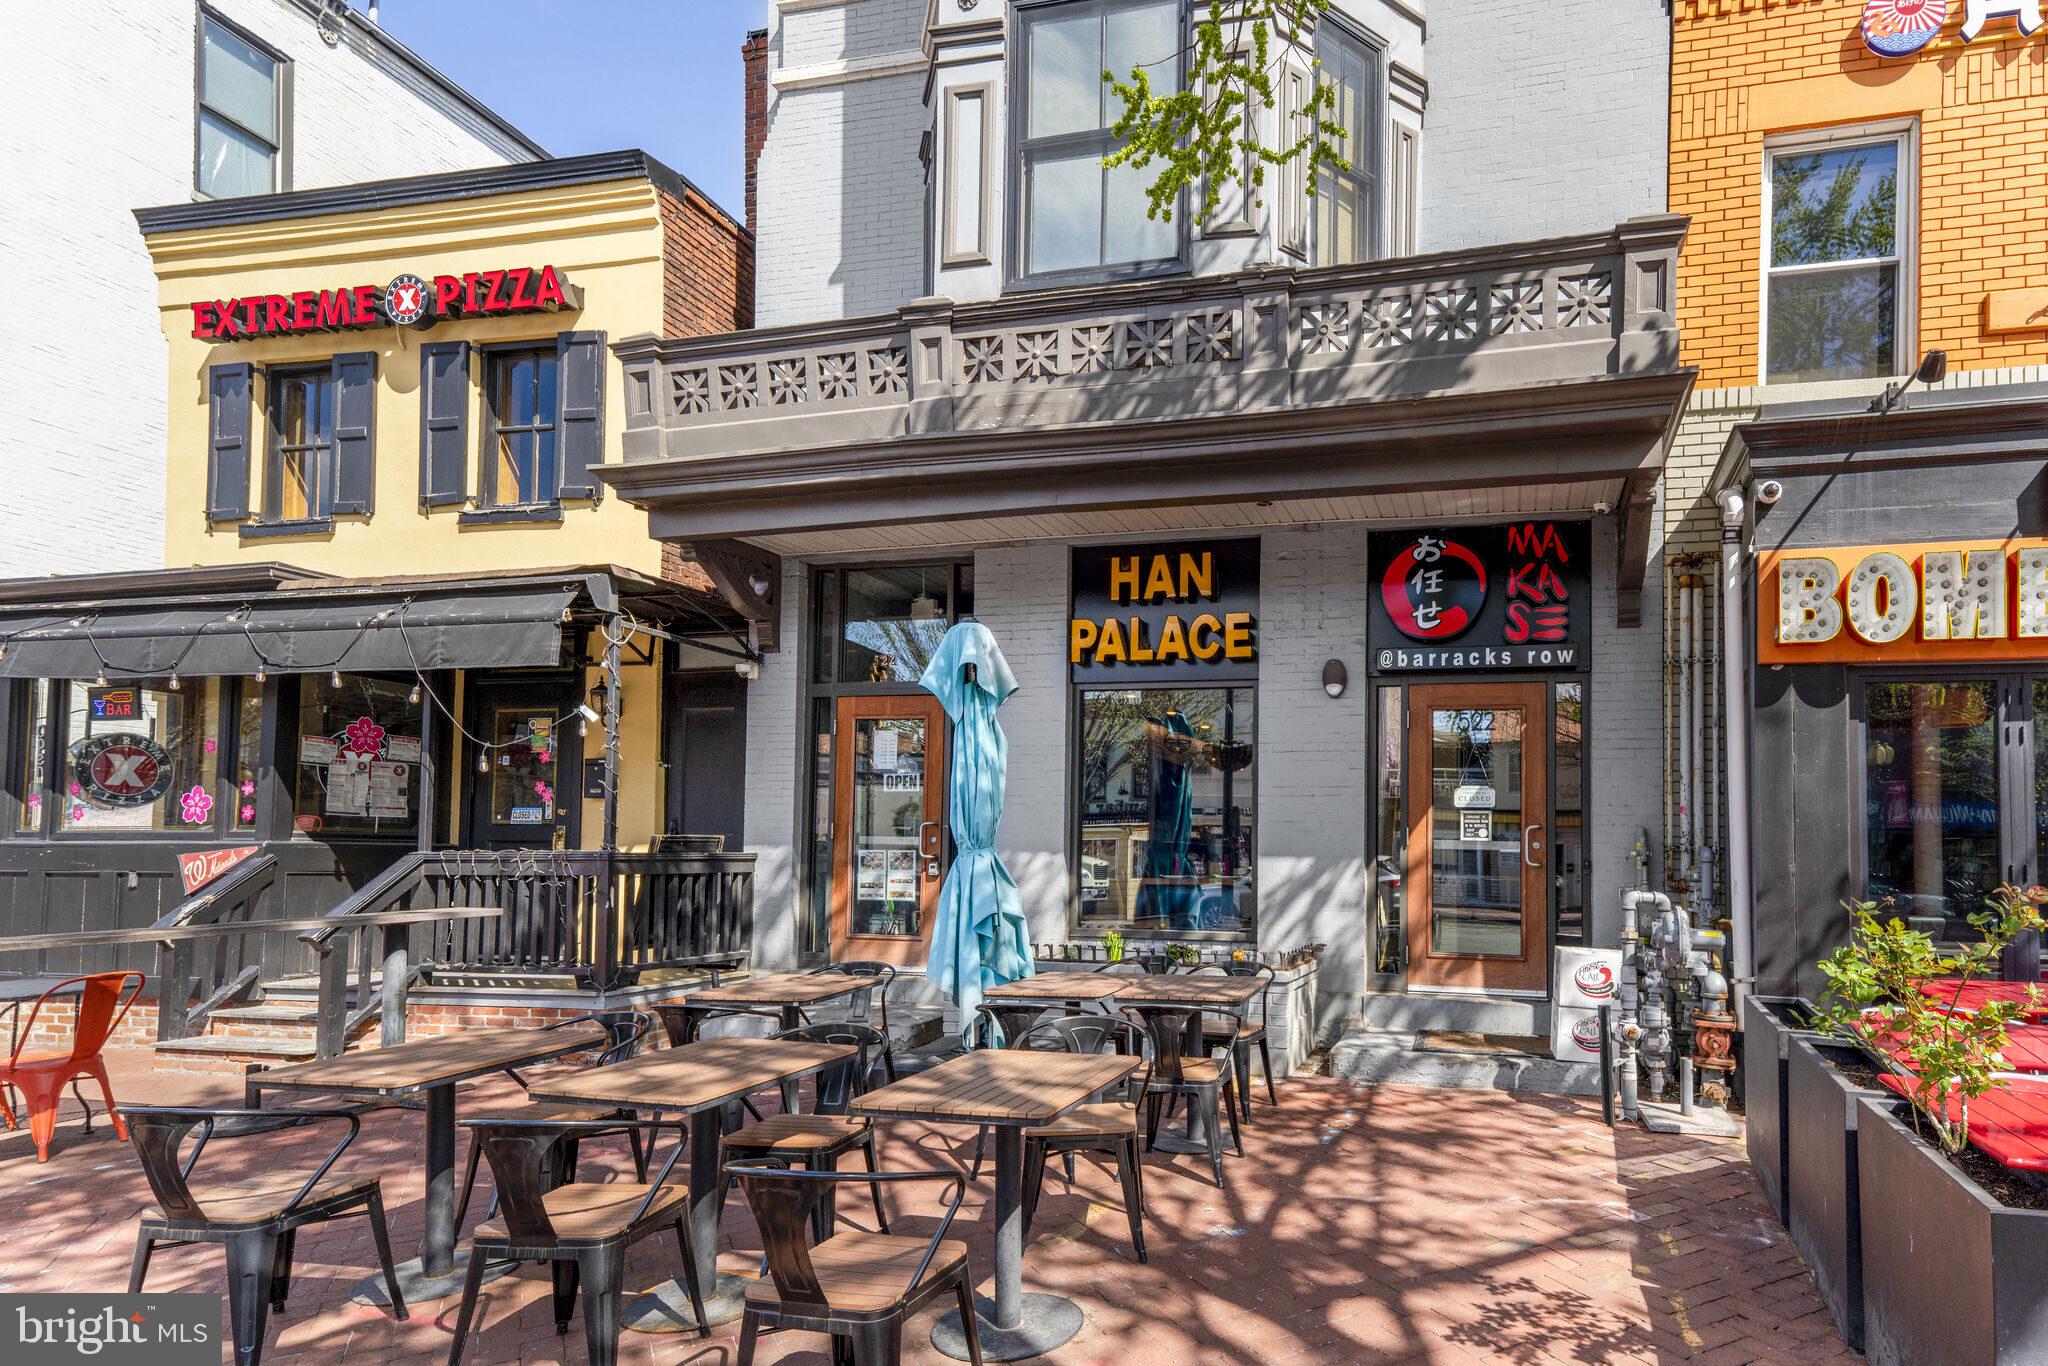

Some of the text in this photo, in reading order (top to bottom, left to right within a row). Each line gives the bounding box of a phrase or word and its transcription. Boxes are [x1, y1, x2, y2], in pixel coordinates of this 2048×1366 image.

[387, 277, 426, 300] EXTREME
[398, 288, 416, 311] X
[191, 265, 566, 338] EXTREME PIZZA
[391, 309, 424, 322] PIZZA
[1110, 552, 1212, 601] HAN
[1411, 535, 1447, 630] お任せ
[1071, 612, 1252, 663] PALACE
[1380, 648, 1573, 667] @barracks row
[106, 703, 132, 716] BAR
[1458, 712, 1496, 732] 522
[79, 736, 171, 772] EXTREME
[104, 753, 148, 787] X
[886, 774, 918, 790] OPEN
[87, 784, 161, 804] PIZZA
[513, 810, 532, 819] CLOSED
[184, 854, 207, 886] W
